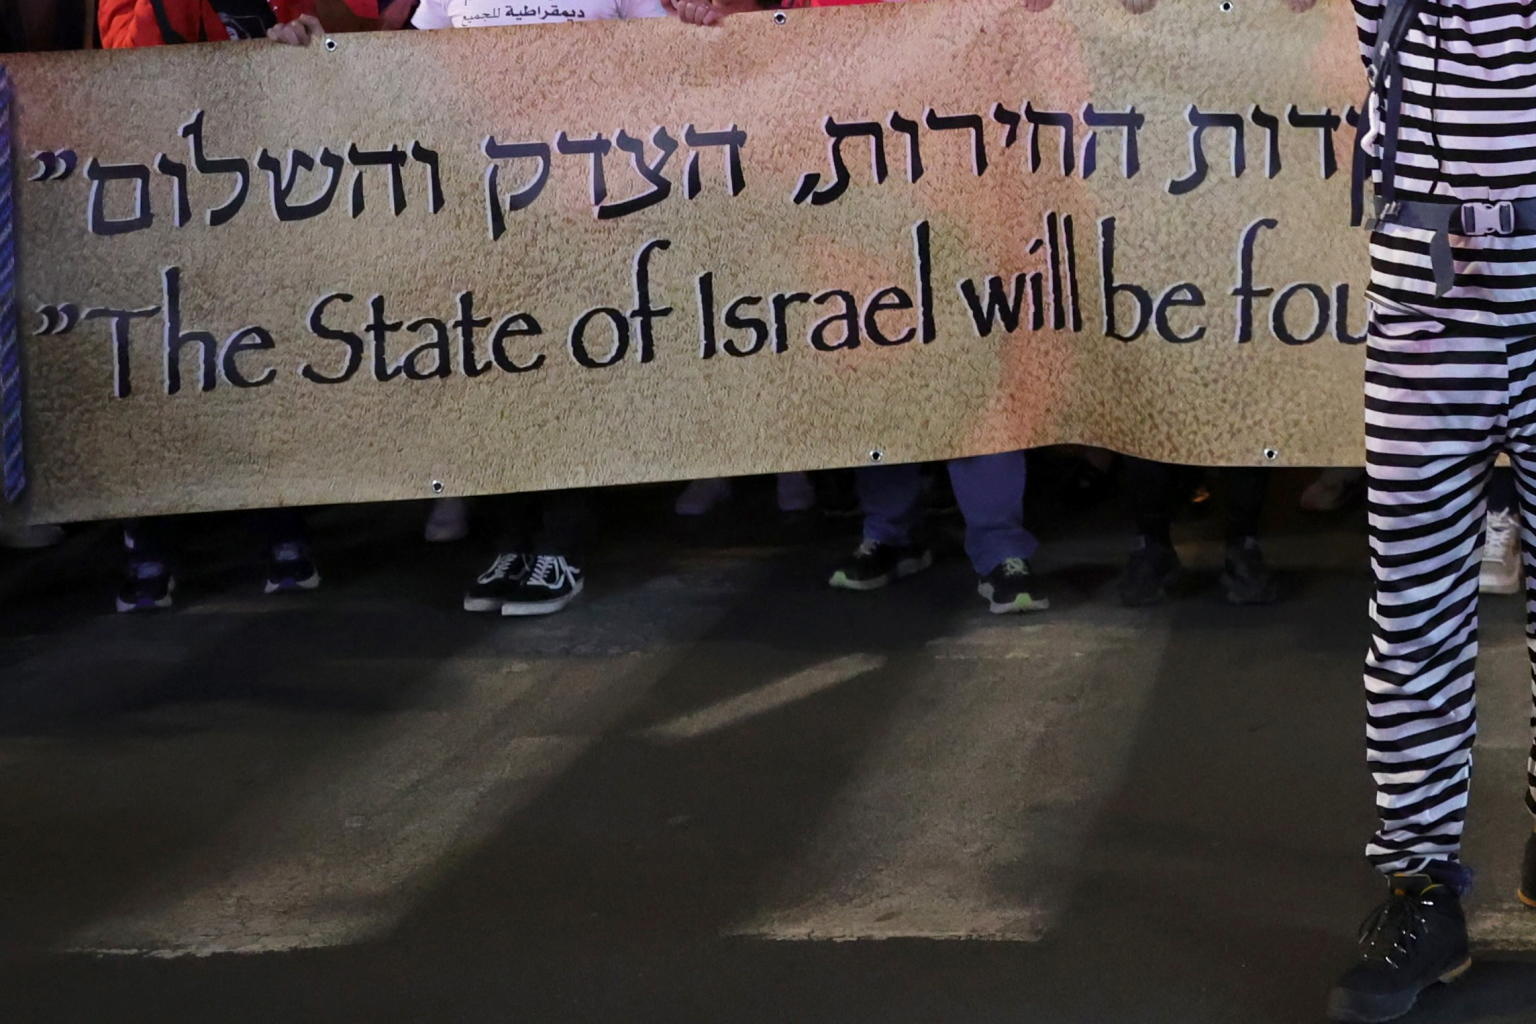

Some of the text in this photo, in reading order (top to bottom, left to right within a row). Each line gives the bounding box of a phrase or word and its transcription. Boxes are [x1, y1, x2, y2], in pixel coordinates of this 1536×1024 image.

[462, 5, 585, 27] ديمقراطية للجميع
[480, 123, 748, 242] הצדק
[792, 100, 1145, 207] החירות,
[299, 290, 546, 385] State
[567, 238, 672, 370] of
[699, 219, 936, 359] Israel
[958, 211, 1081, 337] will
[1100, 216, 1206, 344] be
